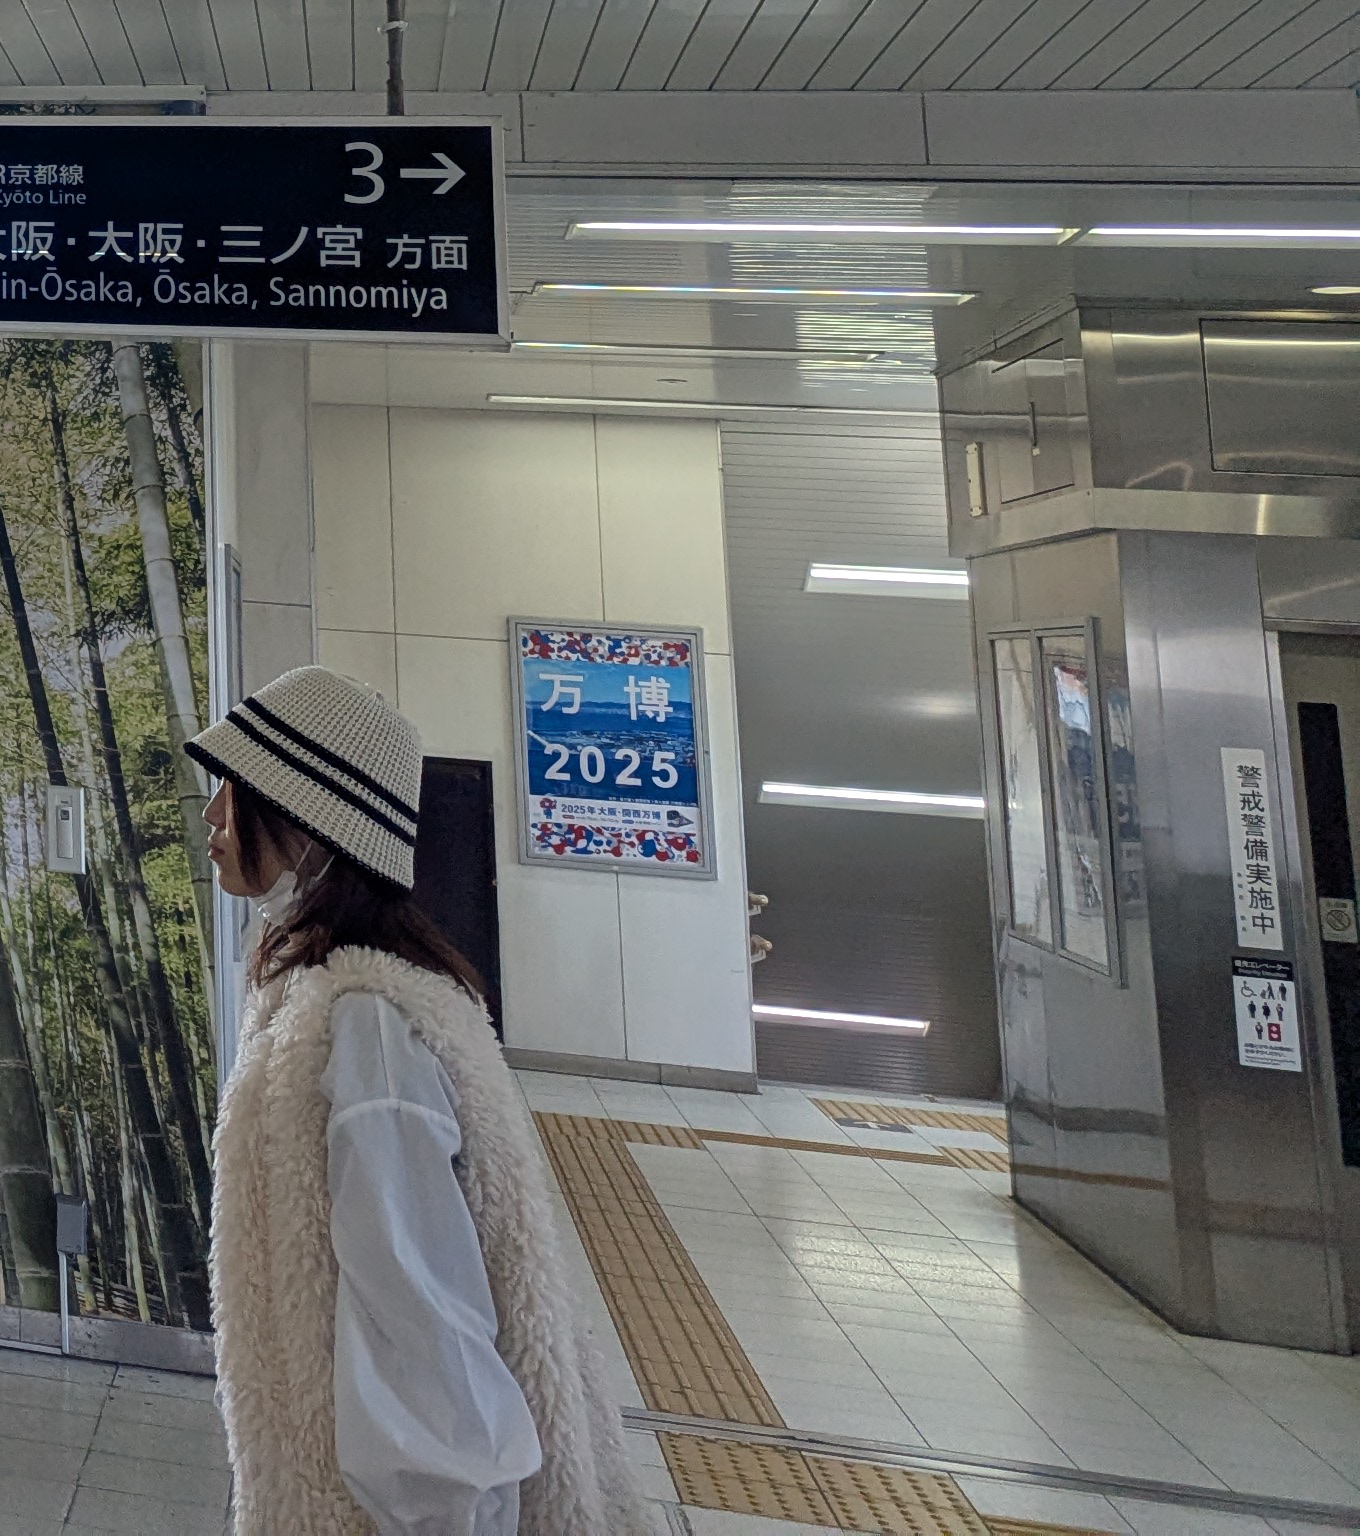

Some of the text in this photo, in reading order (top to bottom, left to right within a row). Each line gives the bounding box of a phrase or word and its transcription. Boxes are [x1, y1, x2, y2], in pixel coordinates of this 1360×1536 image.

[343, 141, 386, 204] 3
[49, 190, 87, 205] Line
[153, 268, 259, 311] Ōsaka,
[269, 278, 448, 317] Sannomiya
[544, 744, 679, 789] 2025
[1237, 764, 1275, 934] 警戒警備実施中
